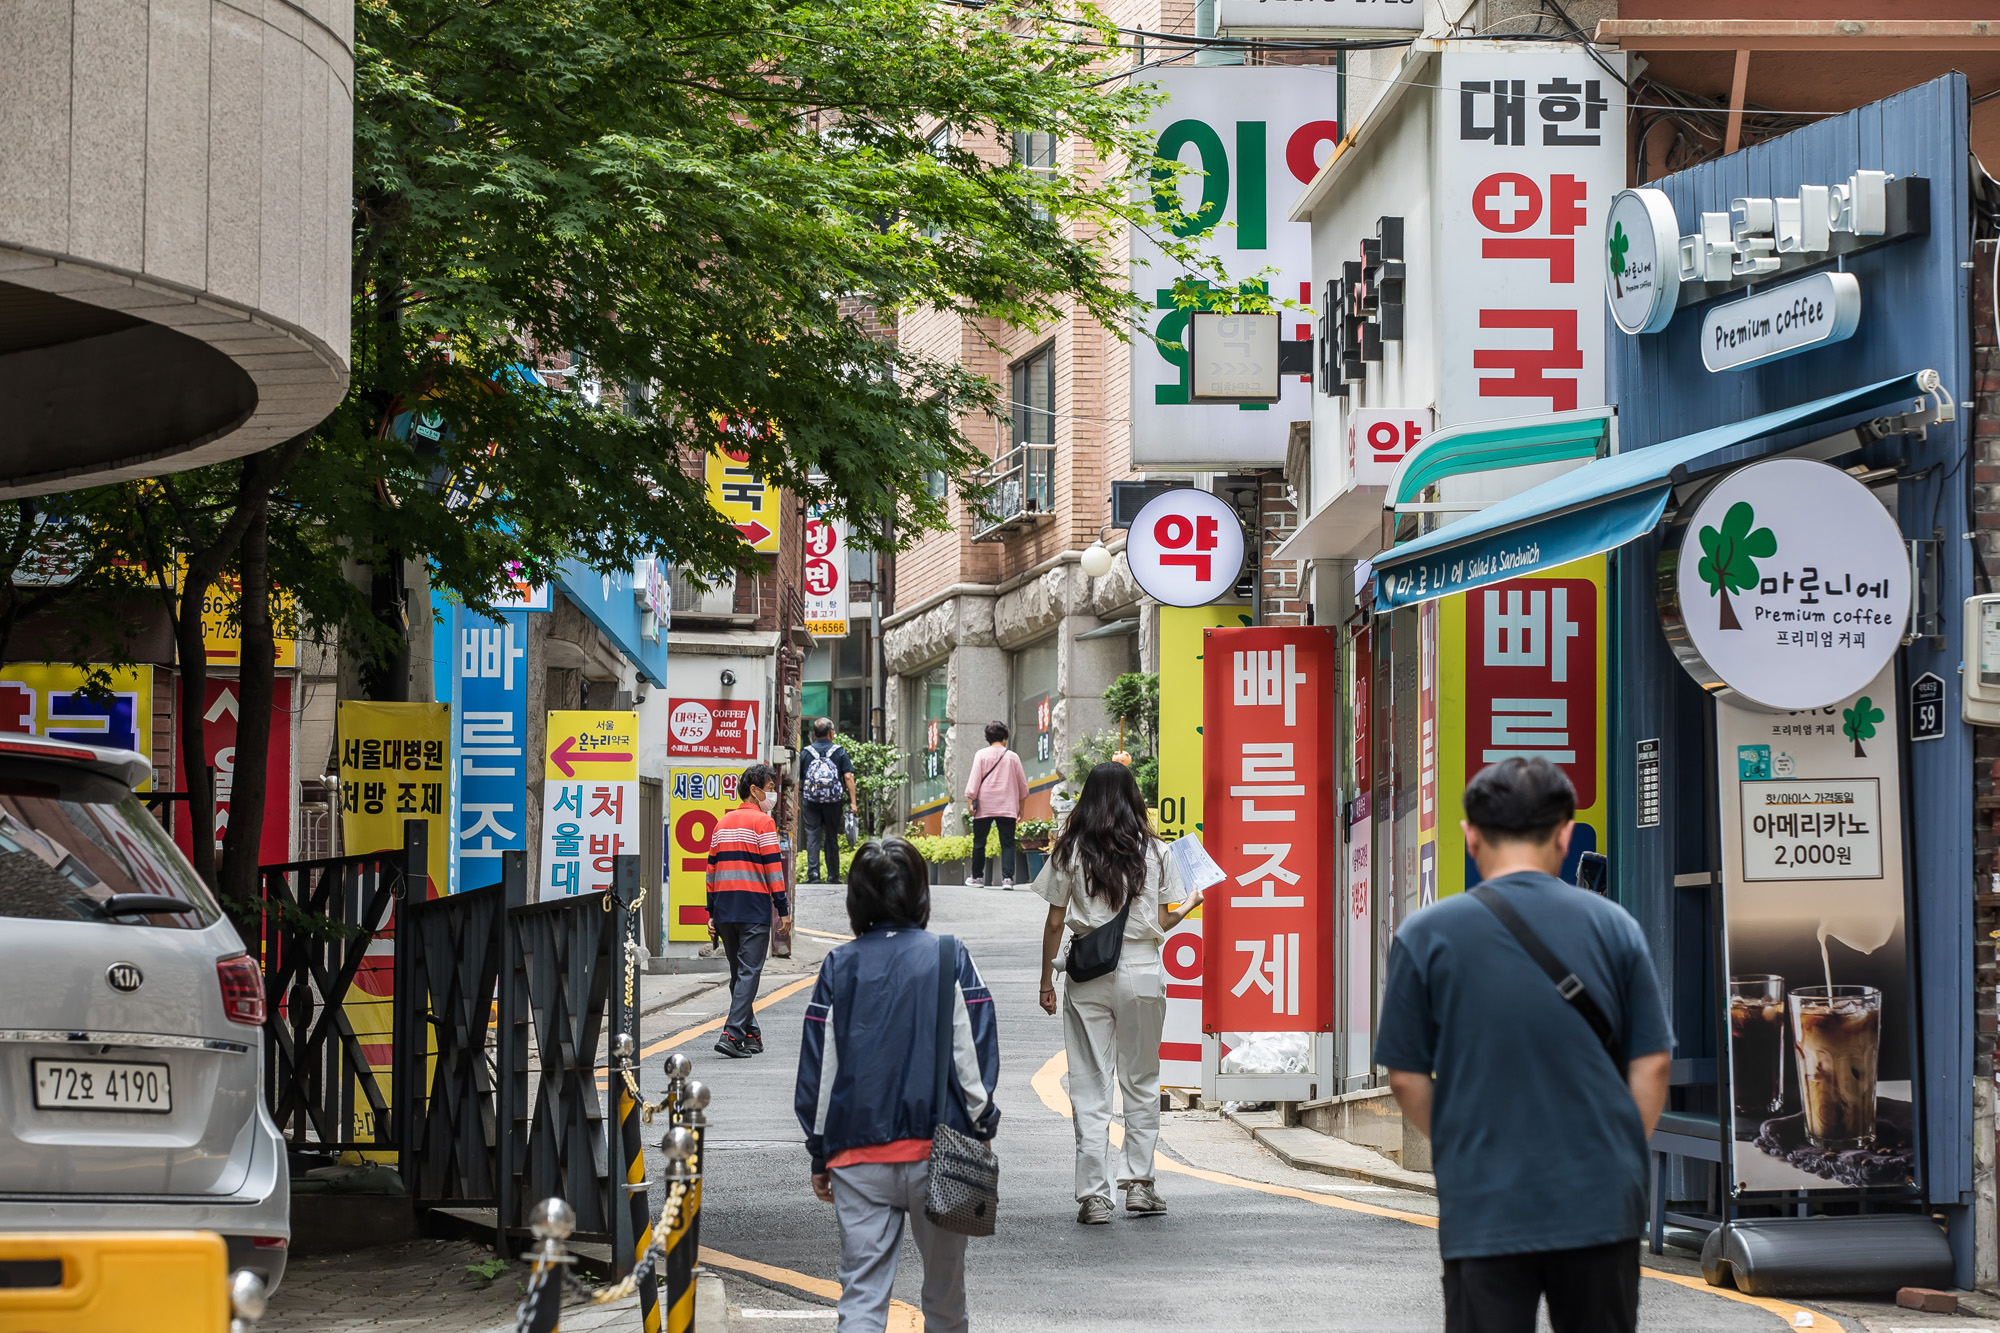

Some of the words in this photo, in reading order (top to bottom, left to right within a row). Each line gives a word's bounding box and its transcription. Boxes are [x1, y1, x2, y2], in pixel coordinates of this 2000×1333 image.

[1460, 77, 1608, 146] 대한
[1678, 169, 1886, 282] 마로니에
[1472, 172, 1587, 412] 약국
[1715, 317, 1771, 350] Premium
[1776, 296, 1824, 335] coffee
[805, 524, 831, 592] 냉면
[1153, 514, 1218, 581] 약
[1396, 559, 1464, 596] 마로니에
[1467, 555, 1490, 580] Salad
[1499, 542, 1540, 572] Sandwich
[1760, 567, 1888, 604] 마로니에
[1755, 606, 1826, 622] Premium
[1833, 608, 1892, 625] coffee
[1776, 630, 1833, 647] 프리미엄
[1838, 631, 1865, 648] 커피
[596, 720, 615, 731] 서울
[675, 712, 708, 724] 대학로
[712, 710, 746, 719] COFFEE
[720, 720, 738, 728] and
[1920, 705, 1935, 730] 59
[579, 732, 630, 751] 온누리약국
[679, 726, 703, 738] #55
[715, 729, 741, 738] MORE
[1771, 724, 1813, 736] 프리미엄
[1815, 724, 1836, 736] 커피
[341, 738, 443, 771] 서울대병원
[342, 781, 387, 815] 처방
[396, 782, 442, 815] 조제
[1765, 793, 1811, 804] 핫/아이스
[1814, 792, 1854, 804] 가격동일
[1230, 644, 1307, 1015] 빠른조제
[1753, 812, 1870, 839] 아메리카노
[552, 785, 584, 895] 서울대
[1774, 844, 1852, 868] 2,000원
[113, 968, 140, 988] KIA
[105, 1070, 159, 1103] 4190
